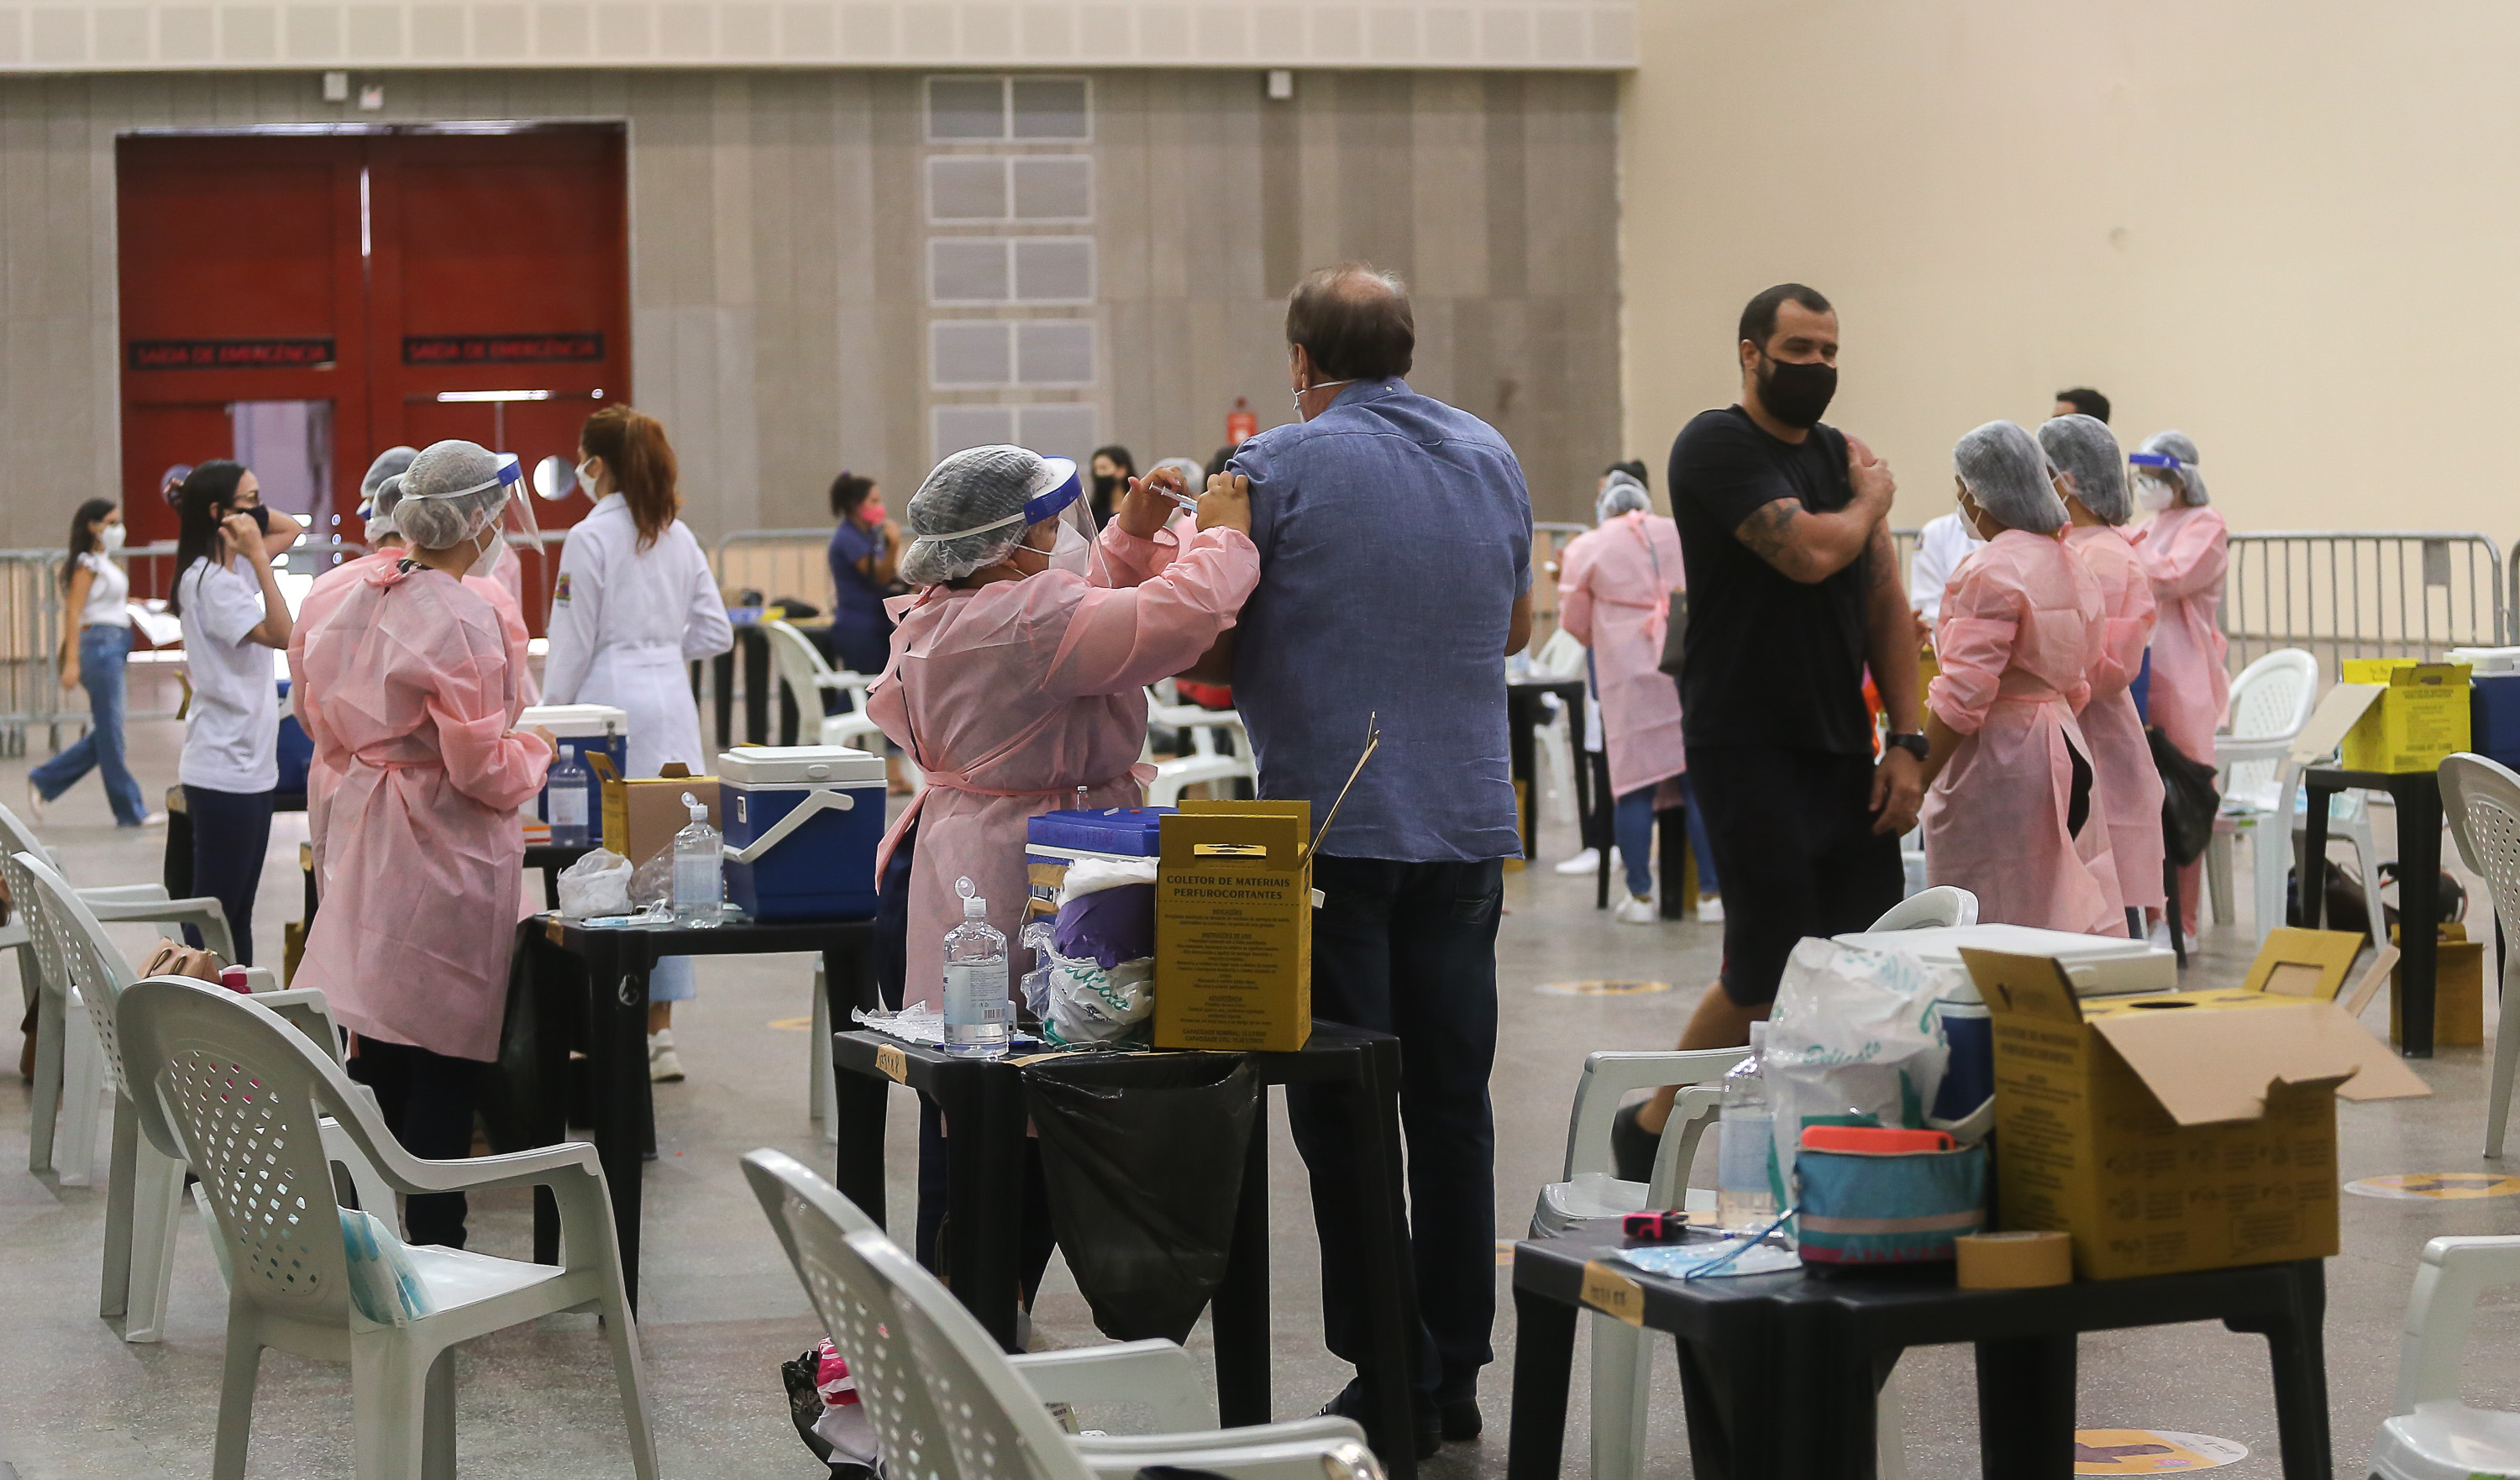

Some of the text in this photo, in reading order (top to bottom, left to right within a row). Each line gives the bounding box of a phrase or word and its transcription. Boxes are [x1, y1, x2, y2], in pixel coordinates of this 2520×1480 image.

[1167, 875, 1290, 888] COLETOR DE MATERIAIS
[1173, 888, 1283, 900] PERFUROCORTANTES
